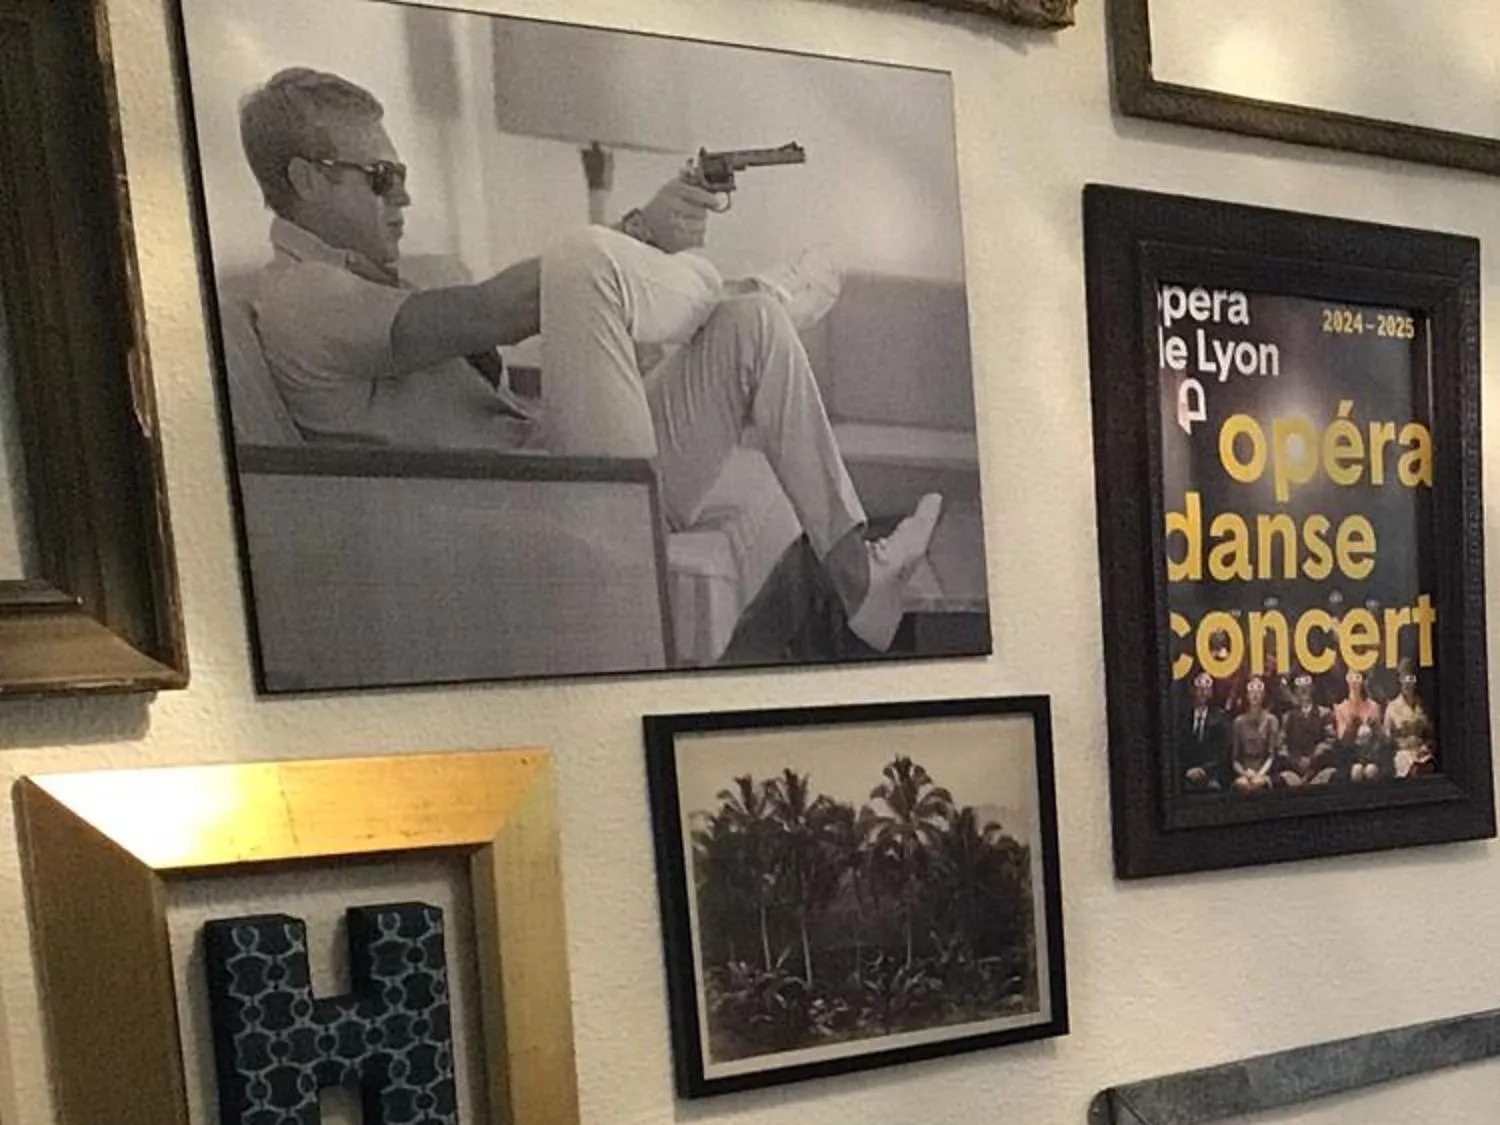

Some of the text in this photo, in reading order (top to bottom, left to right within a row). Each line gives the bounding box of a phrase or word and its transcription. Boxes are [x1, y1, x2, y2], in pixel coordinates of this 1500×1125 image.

[1157, 284, 1250, 327] pera
[1197, 328, 1280, 383] Lyon
[1218, 399, 1433, 502] opéra
[1165, 491, 1377, 582] danse
